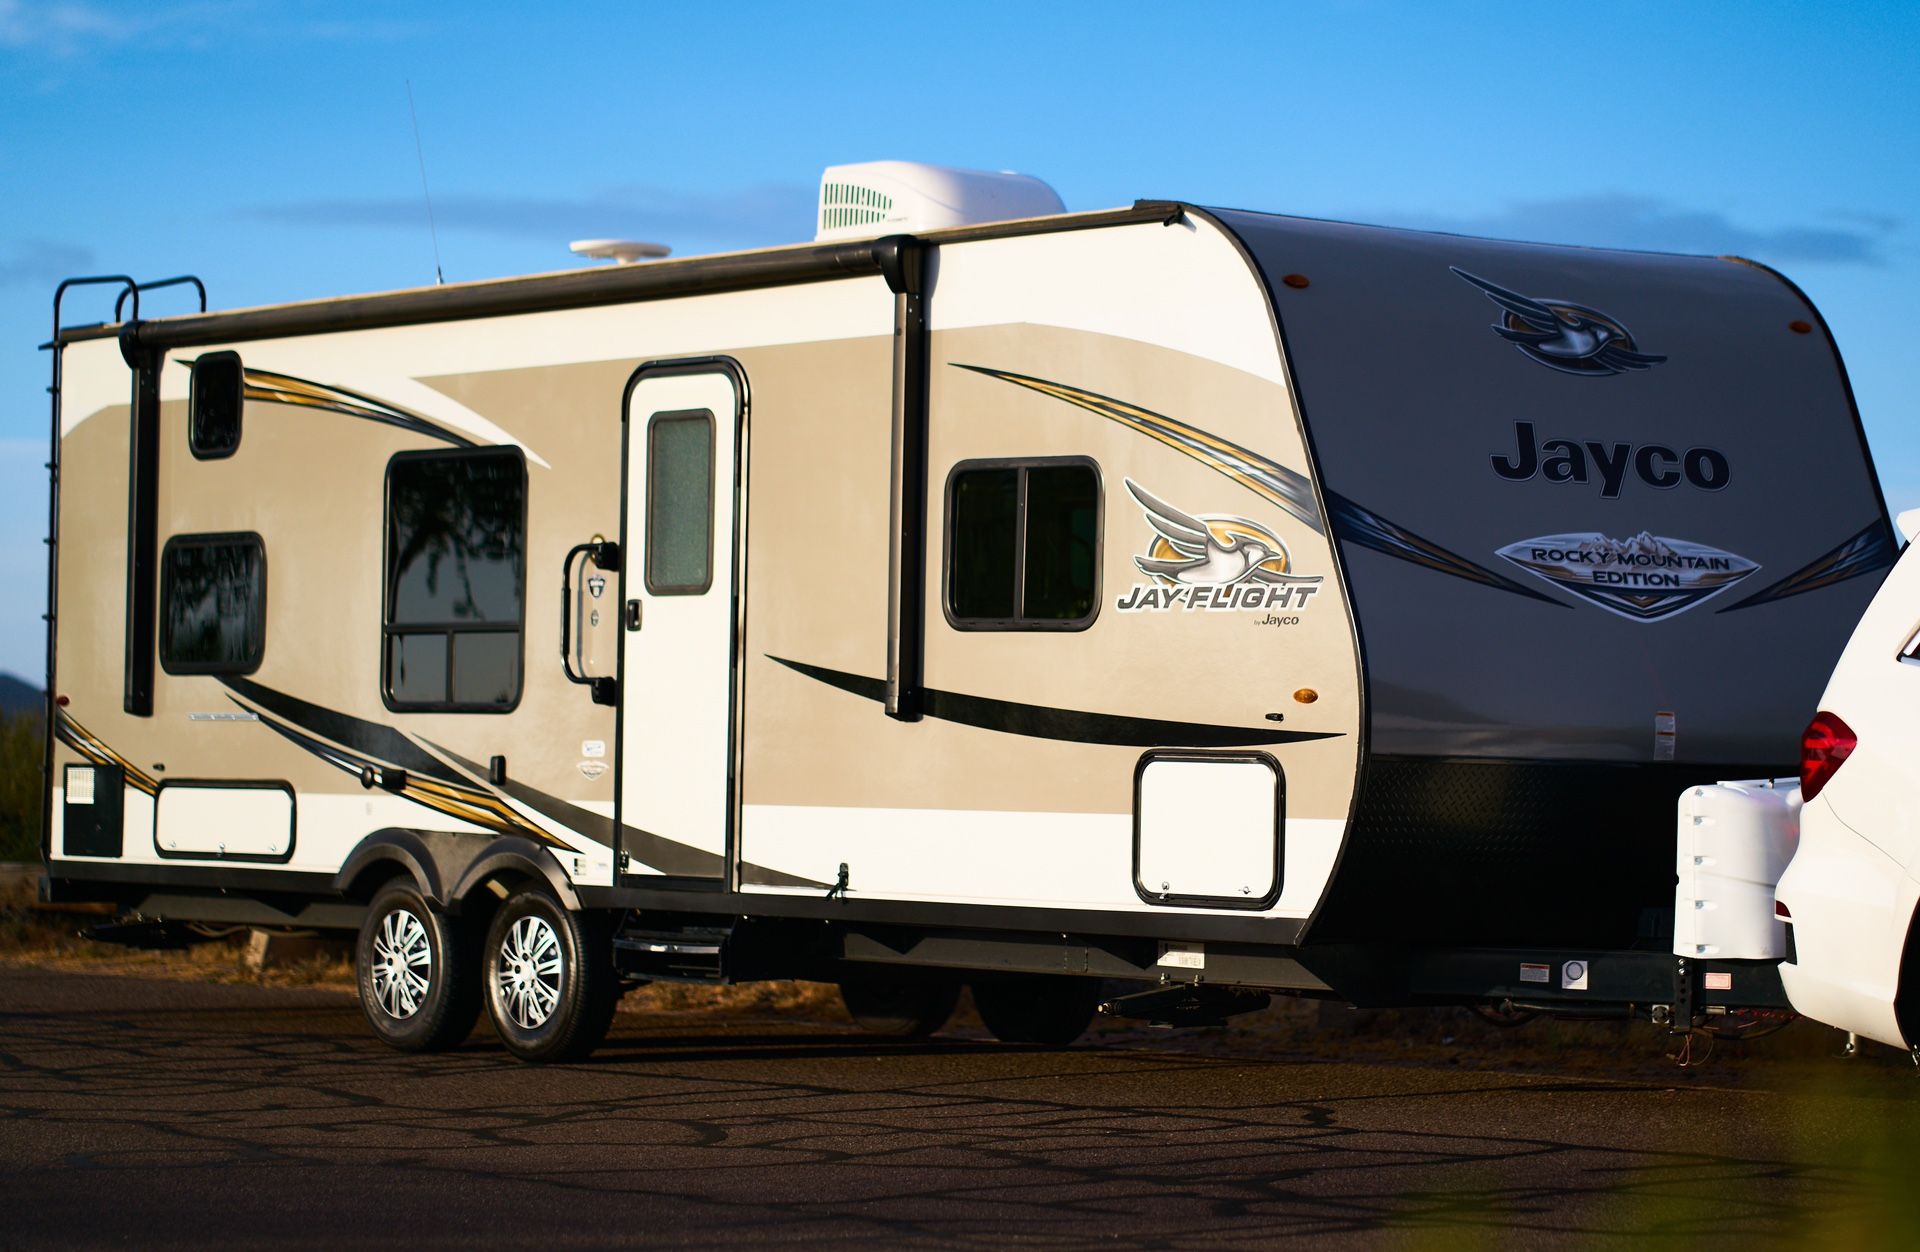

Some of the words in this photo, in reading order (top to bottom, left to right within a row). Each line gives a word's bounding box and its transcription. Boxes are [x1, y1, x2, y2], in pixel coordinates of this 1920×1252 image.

[1490, 420, 1731, 498] Jayco
[1531, 549, 1610, 564] ROCKY
[1617, 550, 1730, 570] MOUNTAIN
[1592, 570, 1680, 586] EDITION
[1186, 586, 1317, 608] FLIGHT
[1262, 613, 1300, 627] Jayco
